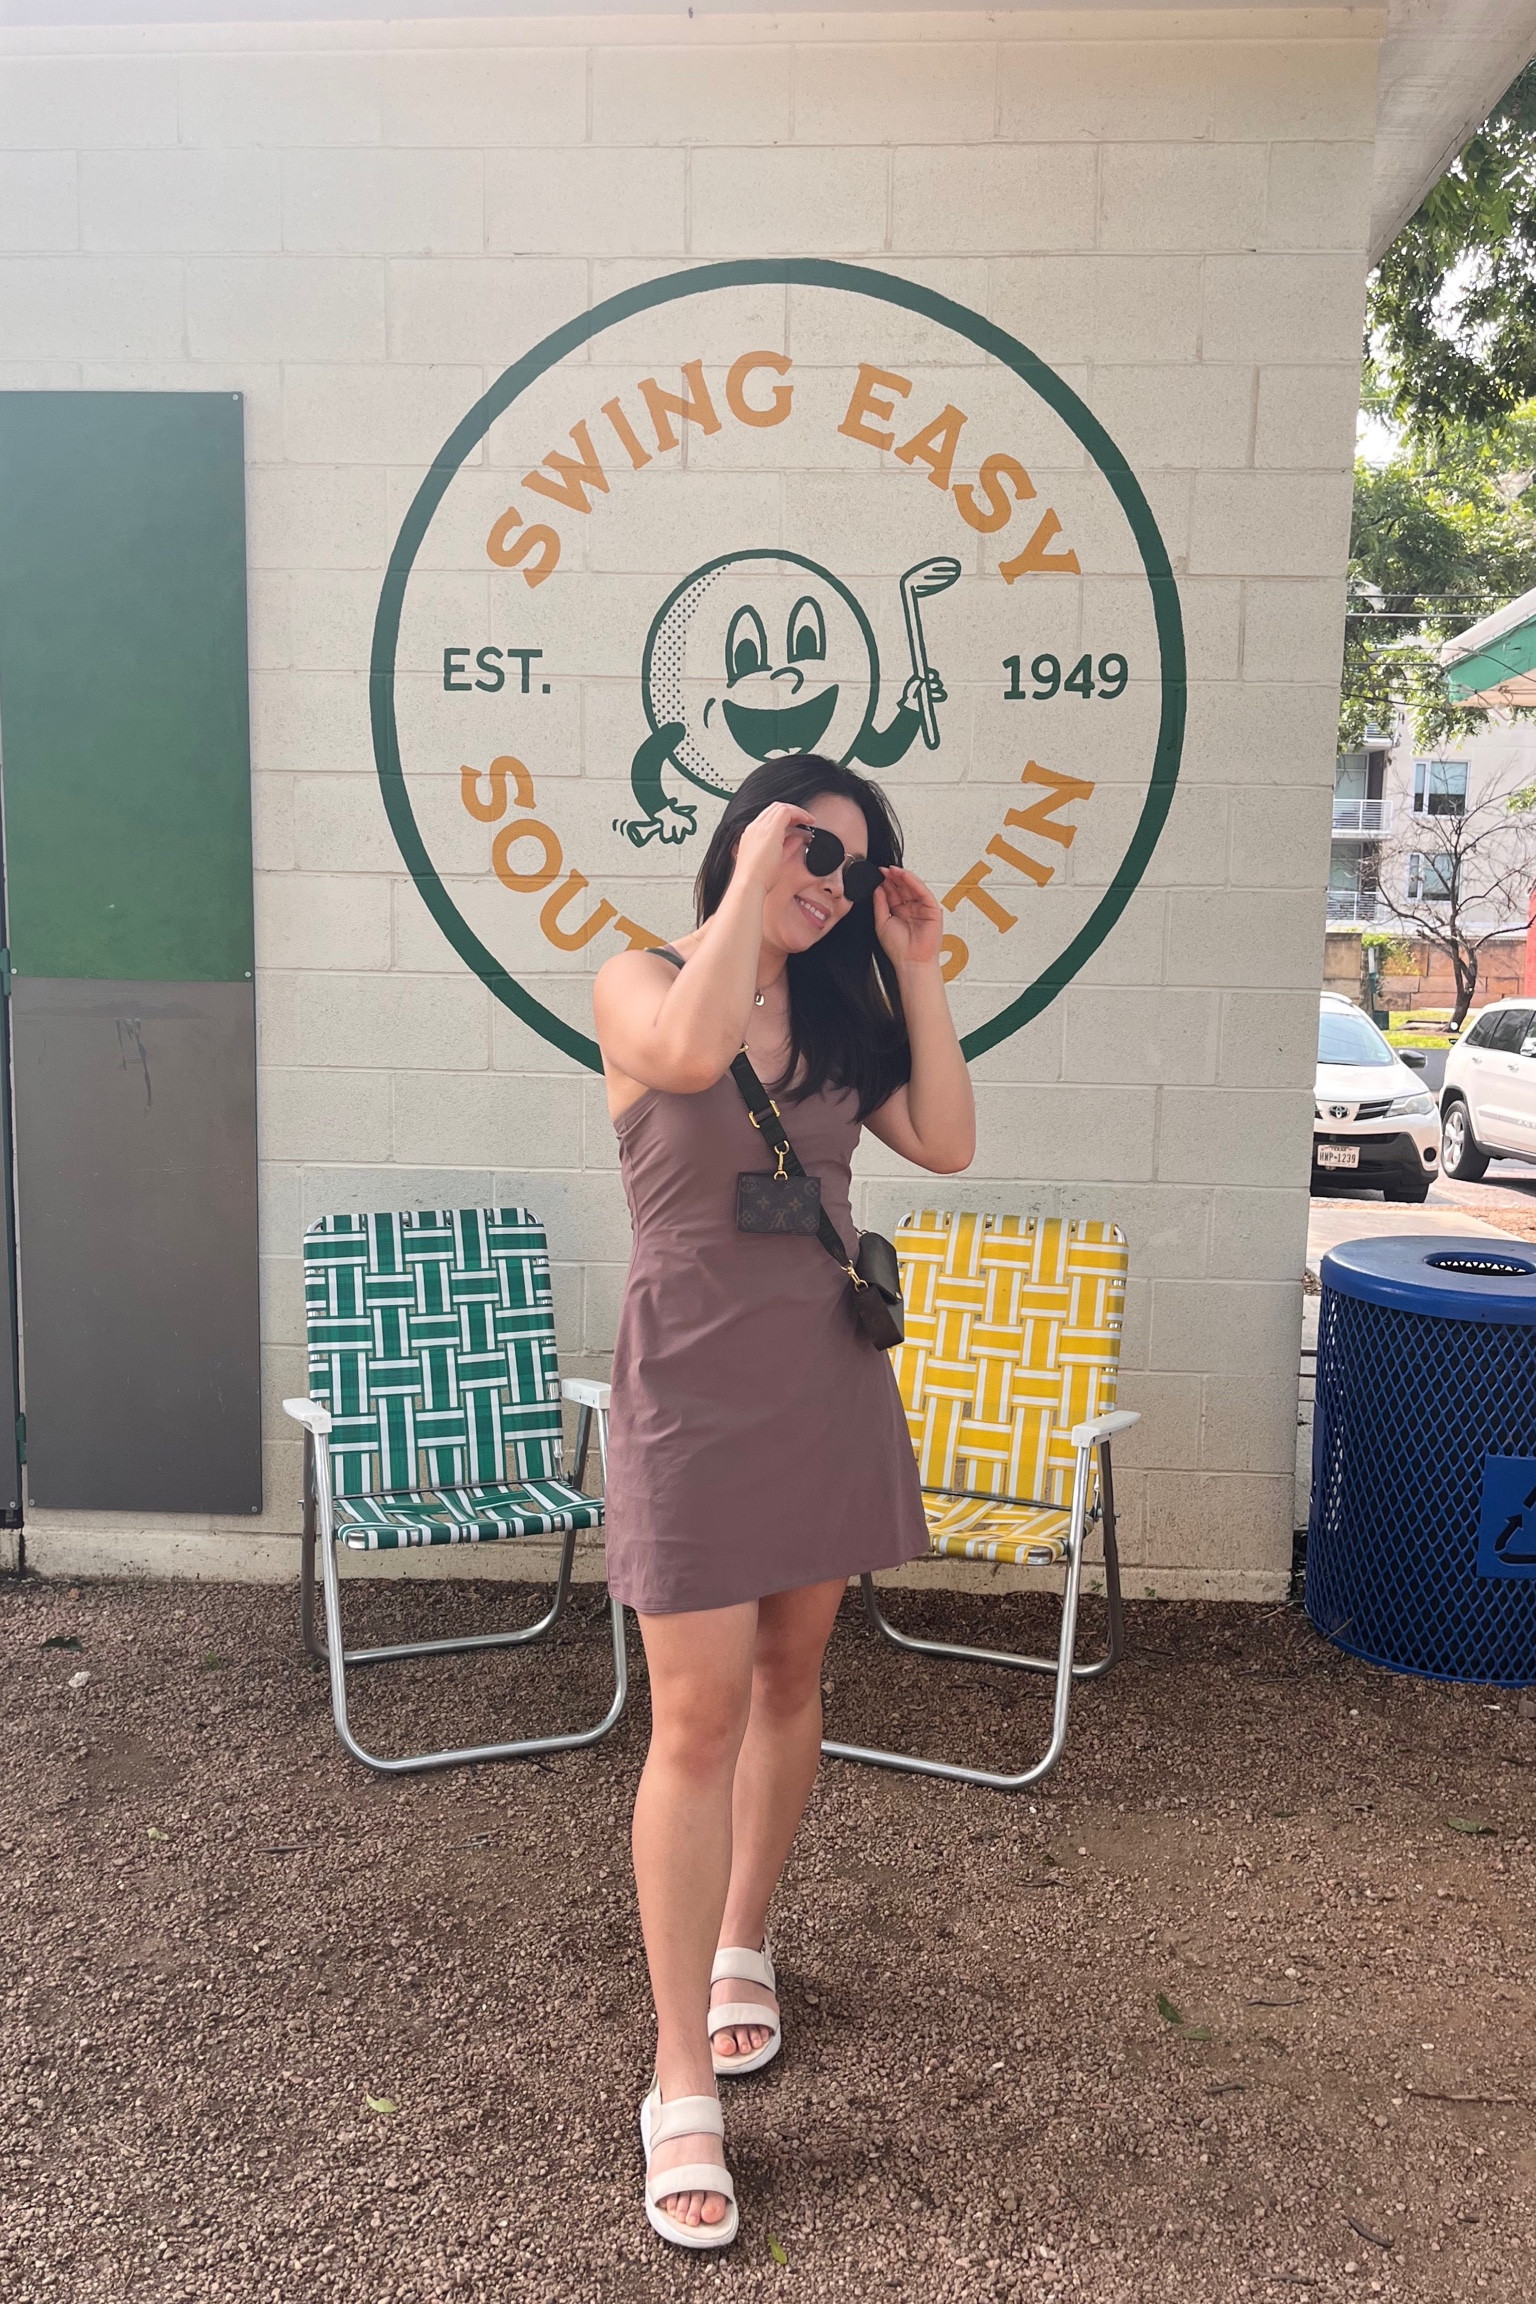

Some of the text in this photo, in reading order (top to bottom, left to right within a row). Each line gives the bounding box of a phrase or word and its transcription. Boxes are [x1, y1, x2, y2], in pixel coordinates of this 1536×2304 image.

[487, 351, 1082, 587] SWING EASY
[443, 646, 551, 694] EST.
[1002, 652, 1129, 700] 1949
[460, 755, 670, 952] SOUT
